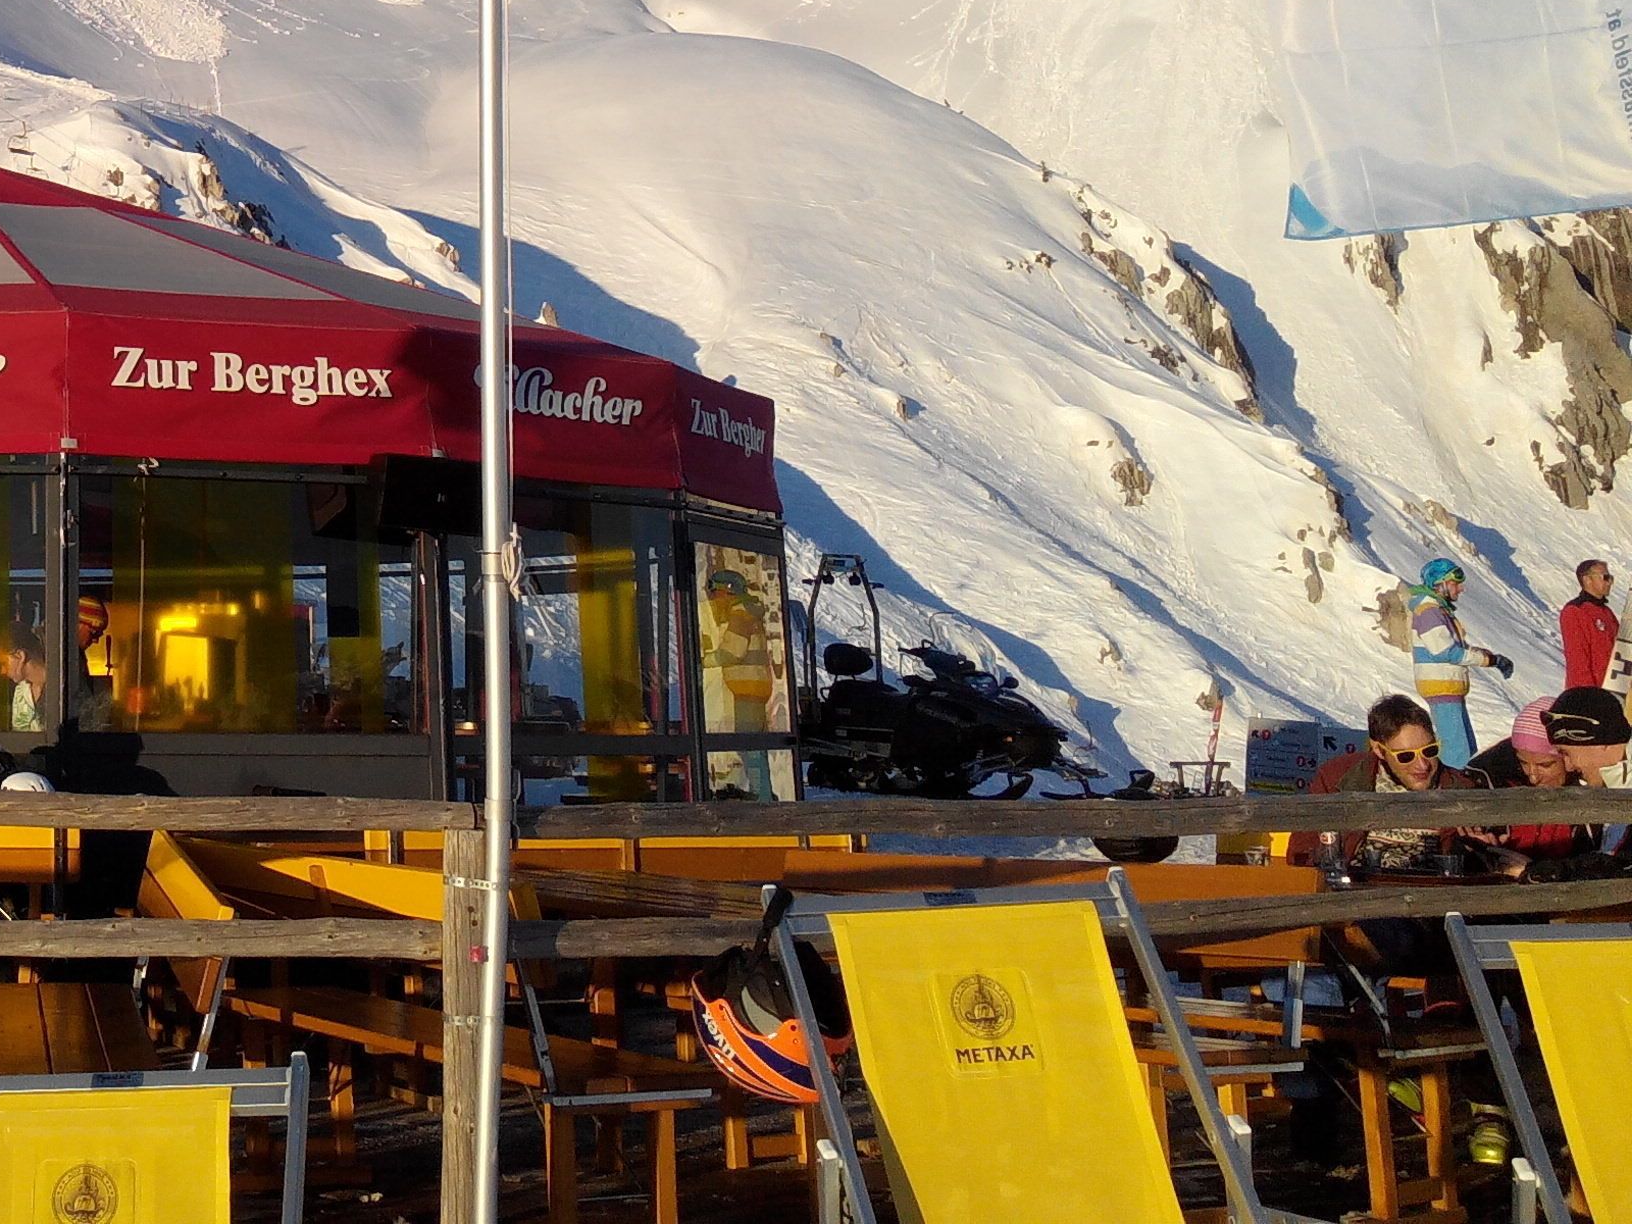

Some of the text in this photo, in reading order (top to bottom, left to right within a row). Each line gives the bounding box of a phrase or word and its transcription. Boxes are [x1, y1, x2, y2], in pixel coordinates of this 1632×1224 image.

[111, 345, 393, 405] Zur Berghex
[691, 398, 718, 439] Zur
[955, 1044, 1035, 1064] METAXA
